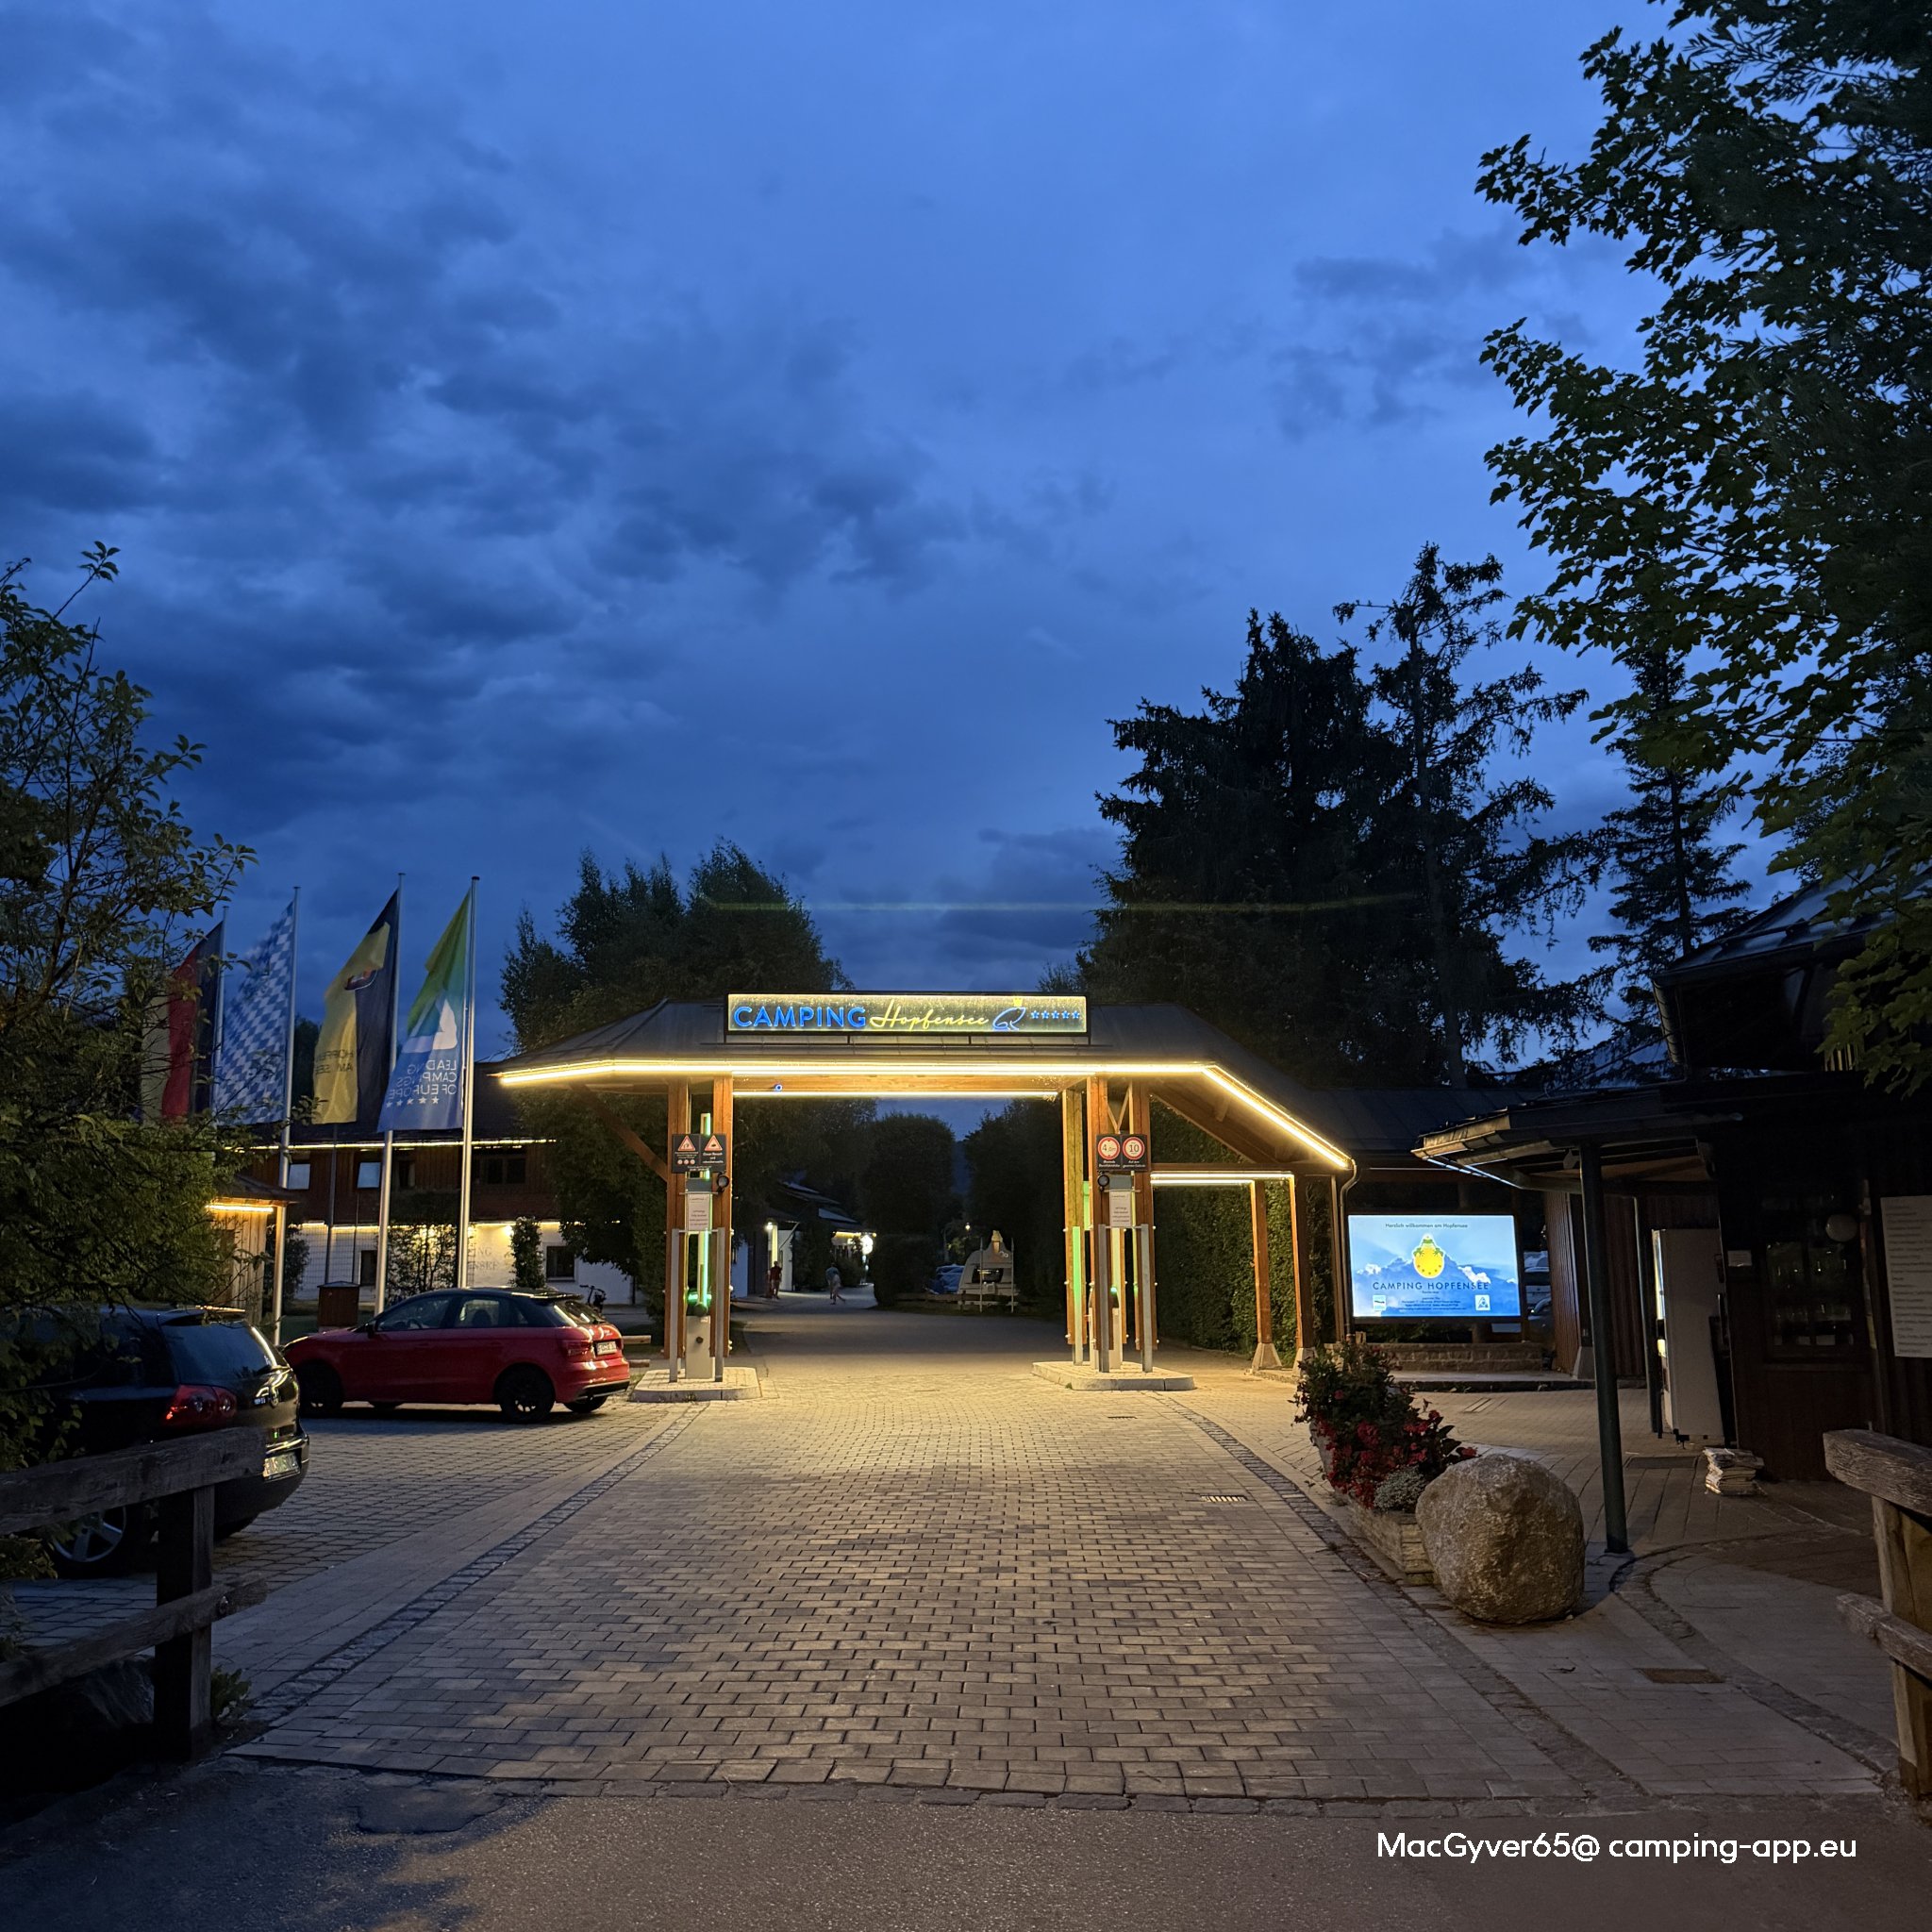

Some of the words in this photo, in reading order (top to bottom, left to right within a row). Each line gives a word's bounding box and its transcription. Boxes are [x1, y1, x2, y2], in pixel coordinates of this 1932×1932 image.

[733, 1005, 866, 1028] CAMPING
[870, 998, 989, 1031] Hopfensee
[1129, 1144, 1140, 1153] 10
[1373, 1281, 1423, 1290] CAMPING
[1427, 1281, 1489, 1291] HOPFENSEE
